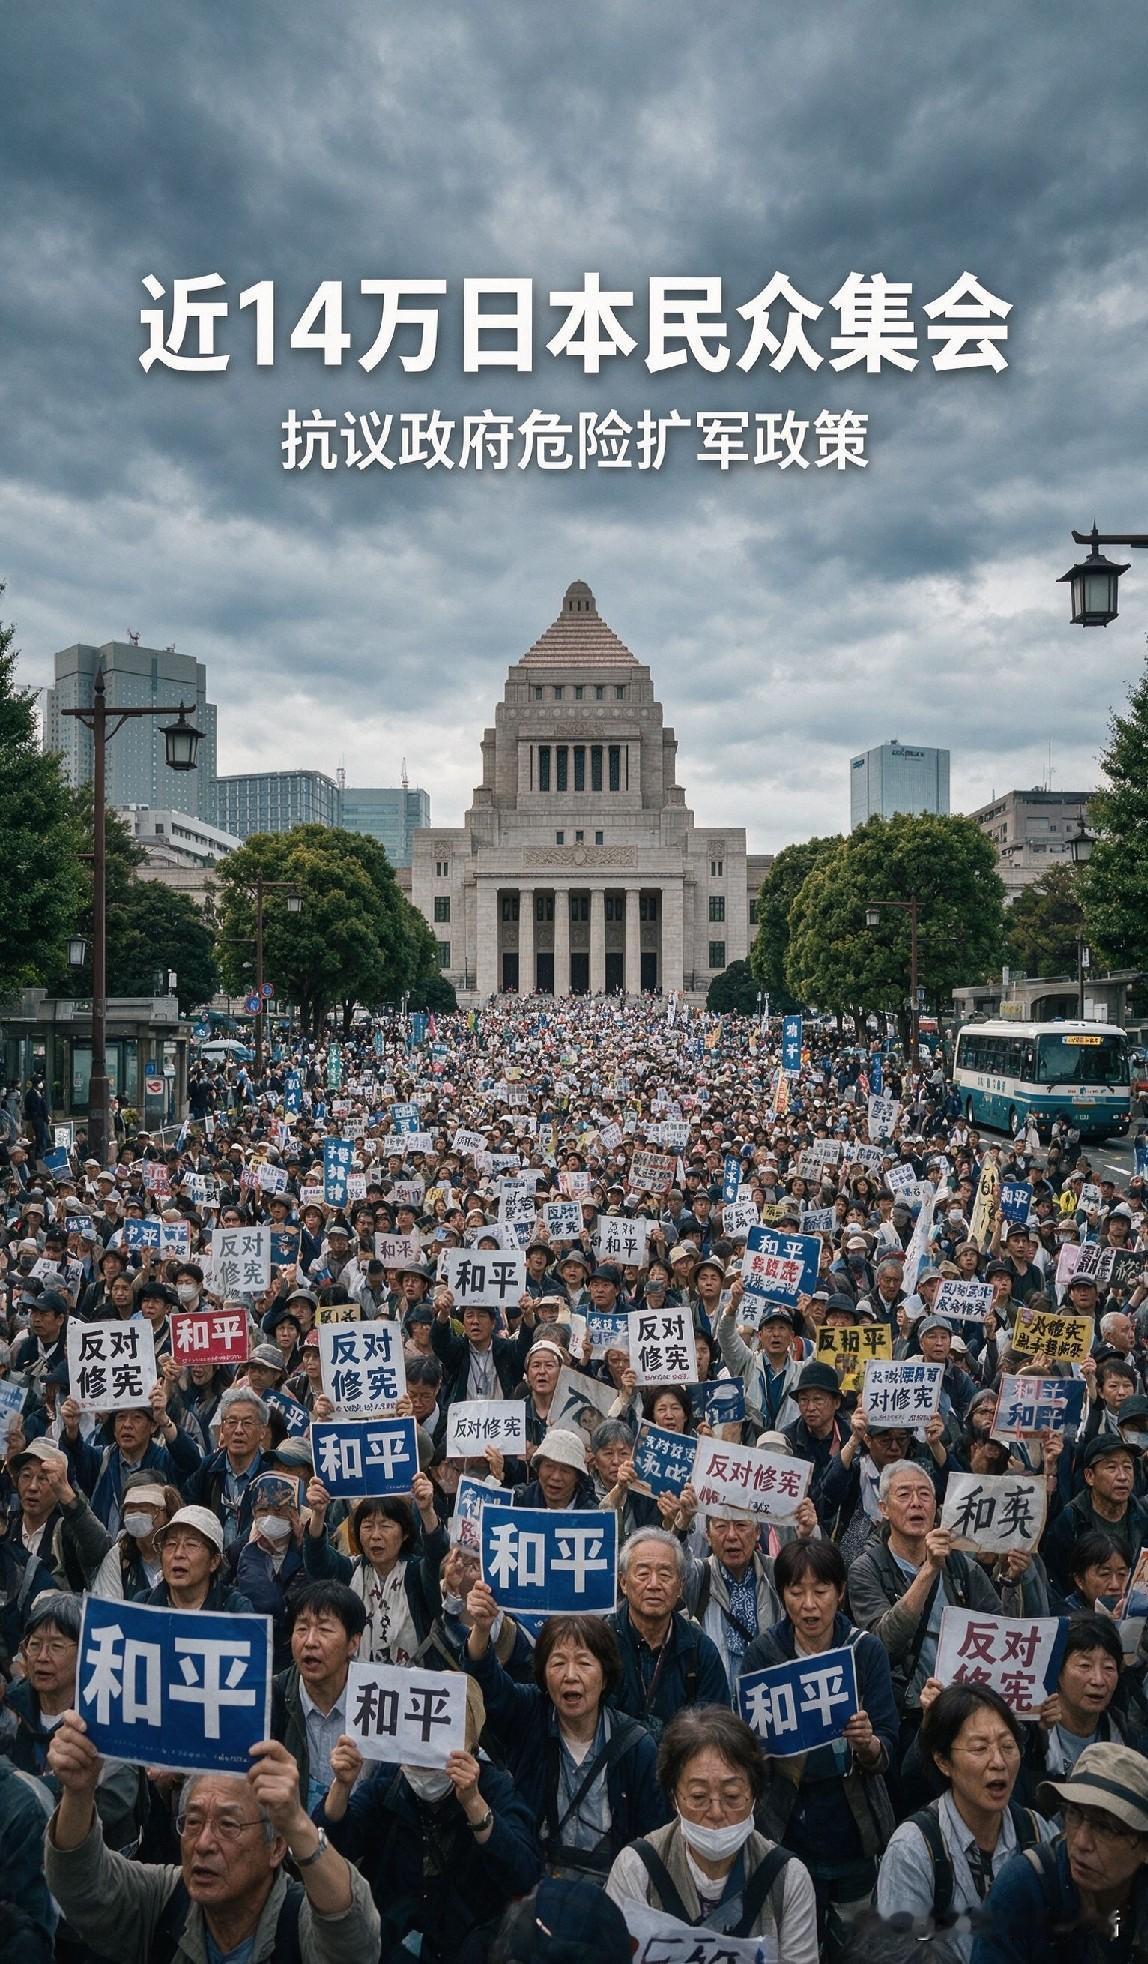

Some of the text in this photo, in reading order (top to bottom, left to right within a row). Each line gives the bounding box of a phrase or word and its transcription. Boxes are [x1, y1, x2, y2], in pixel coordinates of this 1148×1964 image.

[219, 1232, 264, 1257] 反对
[605, 1236, 639, 1258] 和平
[758, 1235, 804, 1259] 和平
[220, 1260, 265, 1286] 修宪
[456, 1259, 519, 1298] 和平
[79, 1327, 140, 1362] 反对
[176, 1315, 244, 1352] 和平
[637, 1314, 685, 1342] 反对
[331, 1328, 393, 1365] 反对
[638, 1344, 690, 1372] 修宪
[76, 1364, 143, 1399] 修宪
[331, 1367, 398, 1402] 修宪
[868, 1385, 933, 1412] 对修宪
[453, 1416, 522, 1440] 反对修宪
[318, 1430, 409, 1482] 和平
[705, 1453, 802, 1498] 反对修宪
[487, 1522, 608, 1594] 和平
[957, 1621, 1042, 1667] 反对
[82, 1623, 256, 1740] 和平
[353, 1681, 452, 1743] 和平
[745, 1665, 850, 1740] 和平
